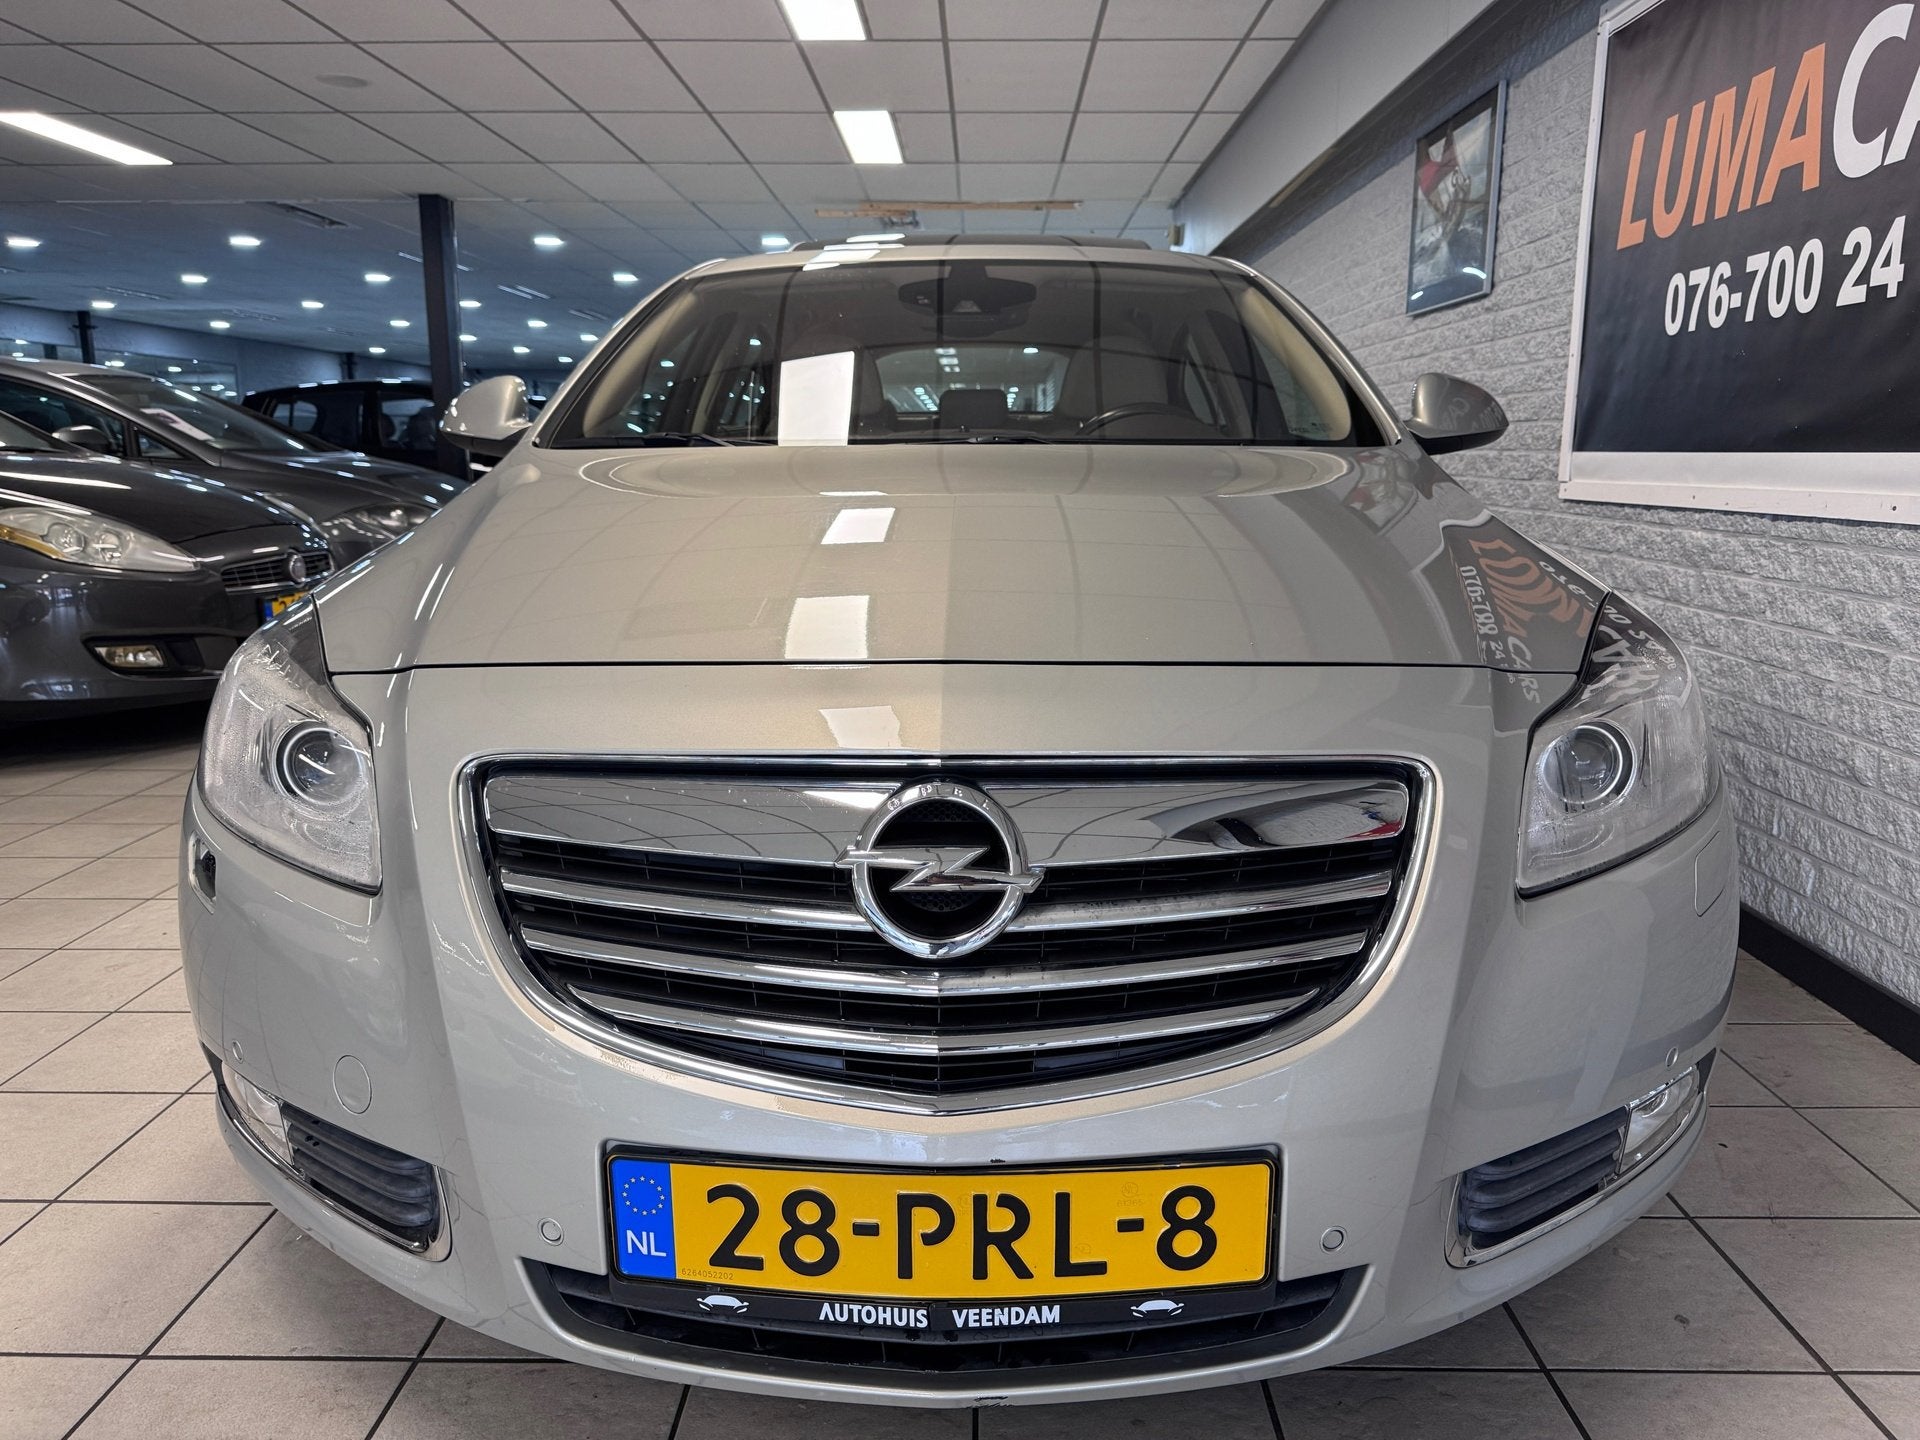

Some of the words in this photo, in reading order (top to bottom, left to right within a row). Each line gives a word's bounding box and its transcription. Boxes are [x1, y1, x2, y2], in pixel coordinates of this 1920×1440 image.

[1664, 238, 1824, 336] 076-700
[1836, 215, 1906, 307] 24
[626, 1229, 666, 1257] NL
[706, 1184, 1217, 1280] 28-PRL-8
[818, 1302, 928, 1328] AUTOHUIS
[951, 1304, 1060, 1328] VEENDAM
